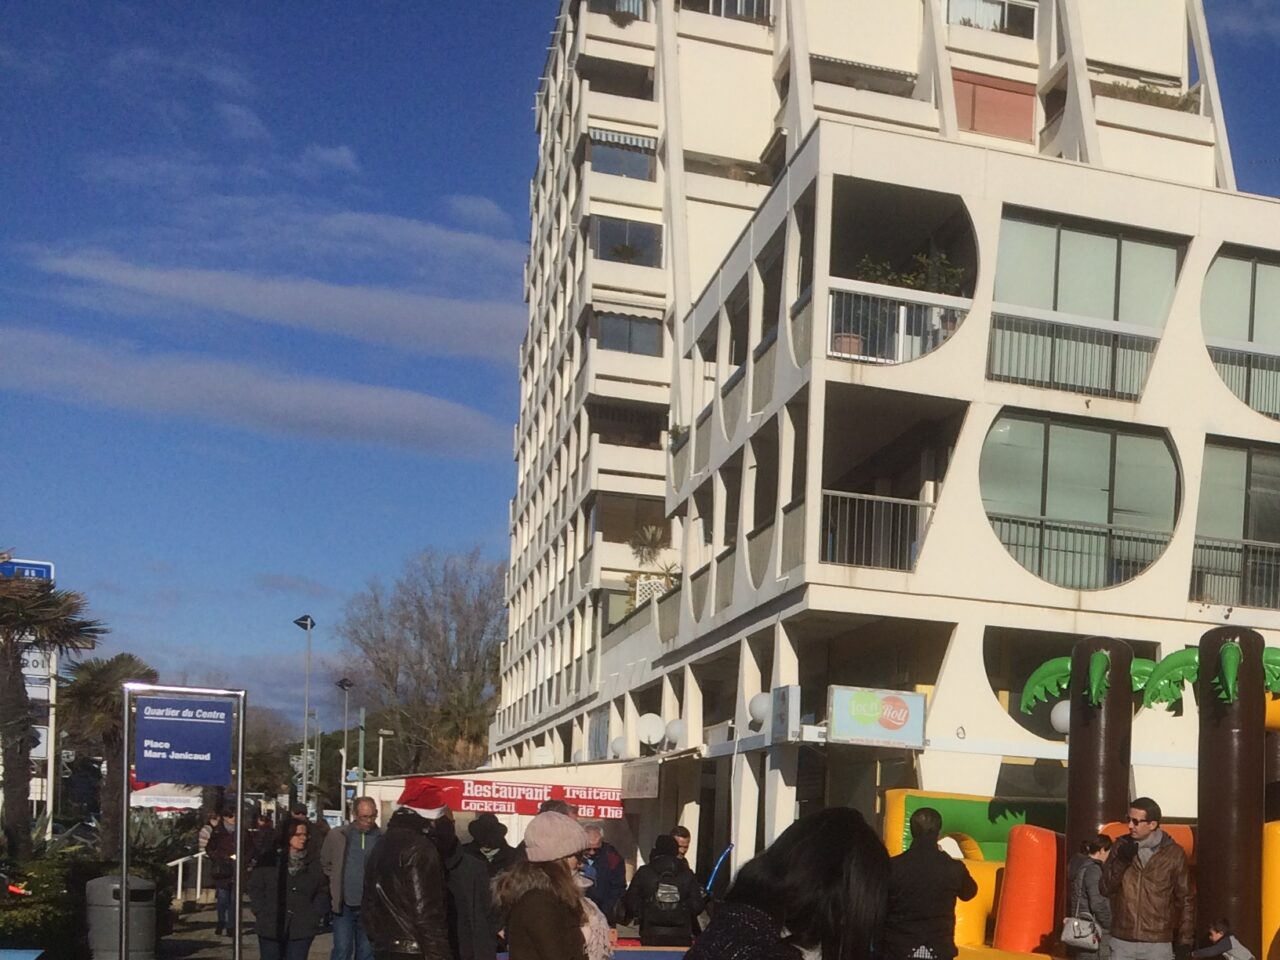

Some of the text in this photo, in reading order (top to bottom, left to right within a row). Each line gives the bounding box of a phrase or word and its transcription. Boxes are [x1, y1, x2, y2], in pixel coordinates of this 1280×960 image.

[144, 706, 226, 719] Quartier du Centre
[144, 739, 171, 749] Place
[144, 749, 211, 761] Mars Janicaud
[462, 780, 622, 801] Restaurant Traiteur
[461, 799, 516, 813] Cocktail
[578, 804, 595, 817] de
